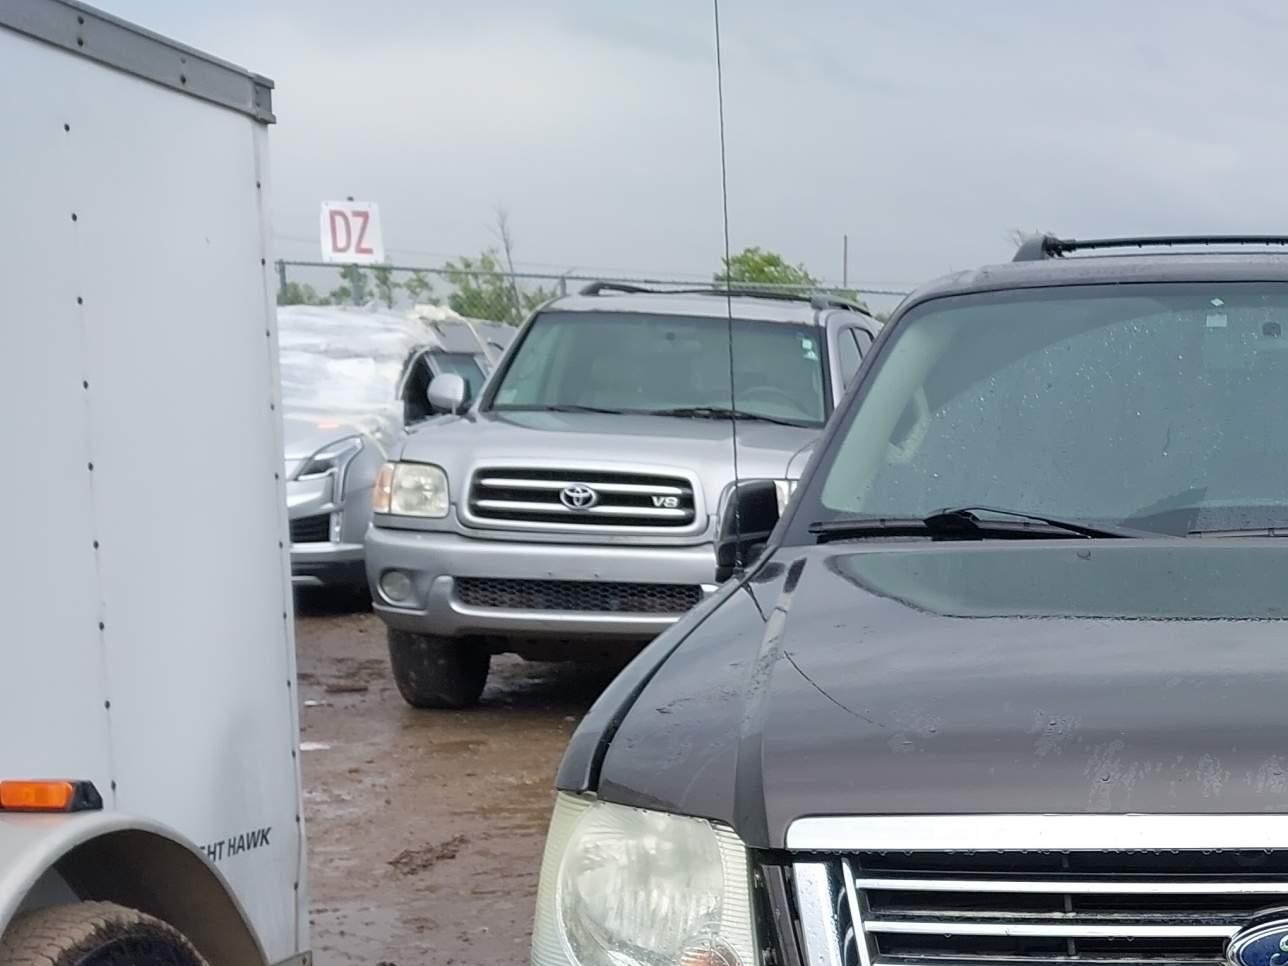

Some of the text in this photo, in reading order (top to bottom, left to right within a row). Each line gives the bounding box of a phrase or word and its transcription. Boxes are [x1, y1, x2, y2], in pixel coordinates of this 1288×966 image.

[329, 209, 374, 254] DZ
[651, 496, 678, 508] V8
[227, 826, 271, 857] HAWK
